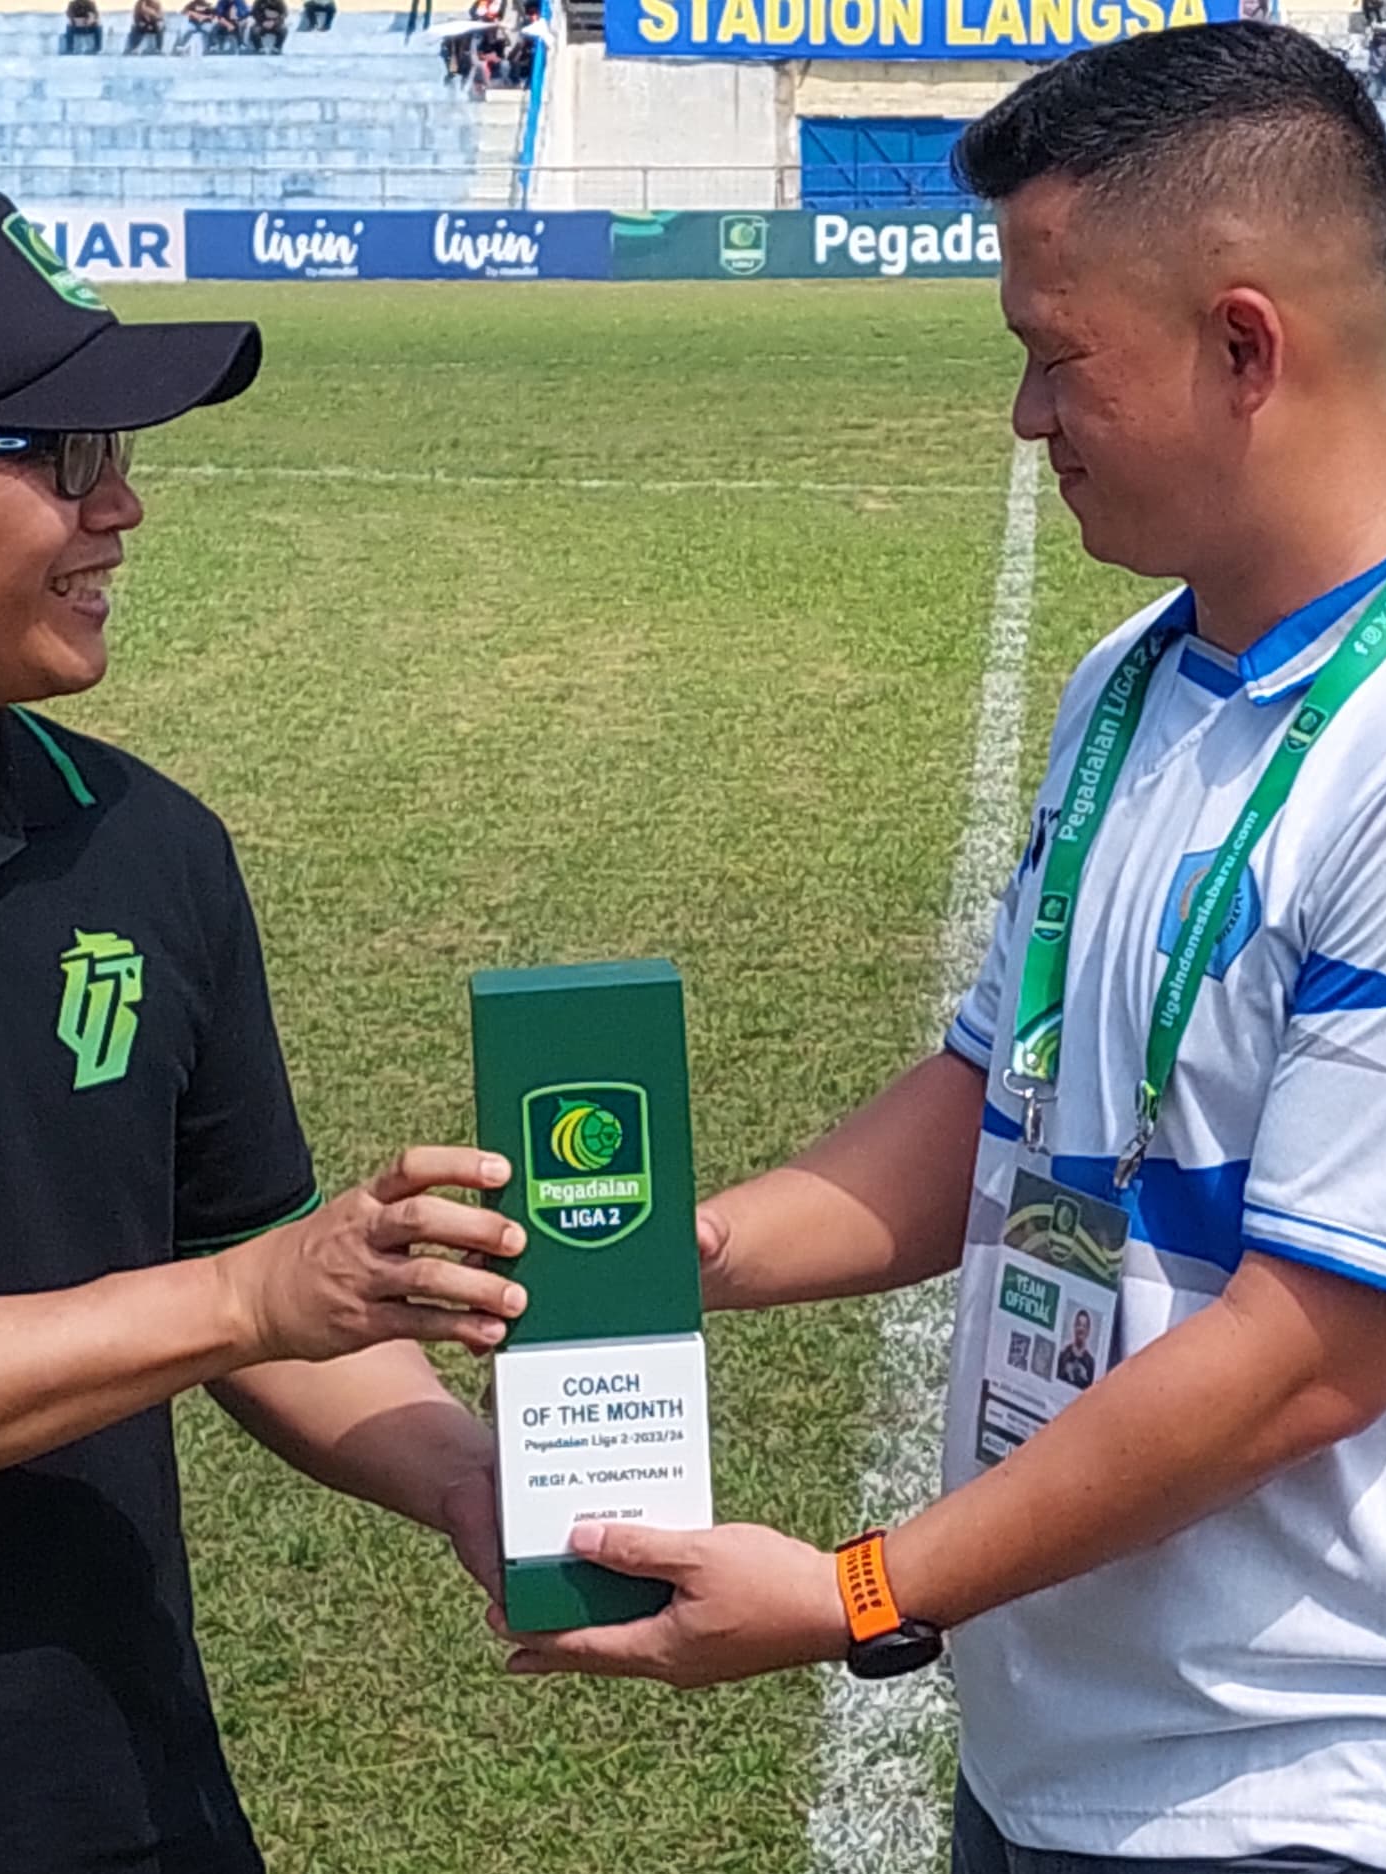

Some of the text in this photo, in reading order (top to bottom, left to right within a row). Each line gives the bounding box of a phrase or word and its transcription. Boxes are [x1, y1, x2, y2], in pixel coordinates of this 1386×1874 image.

[638, 0, 1208, 46] STADION LANGSA
[1059, 718, 1120, 843] Pegadaian
[1102, 664, 1142, 718] LIGA
[539, 1180, 639, 1204] Pegadaian
[560, 1208, 621, 1229] LIGA 2
[1015, 1273, 1047, 1301] TEAM
[563, 1374, 640, 1397] COACH
[522, 1398, 684, 1427] OF THE MONTH
[592, 1434, 617, 1449] Liga
[587, 1466, 668, 1483] YONATHAN
